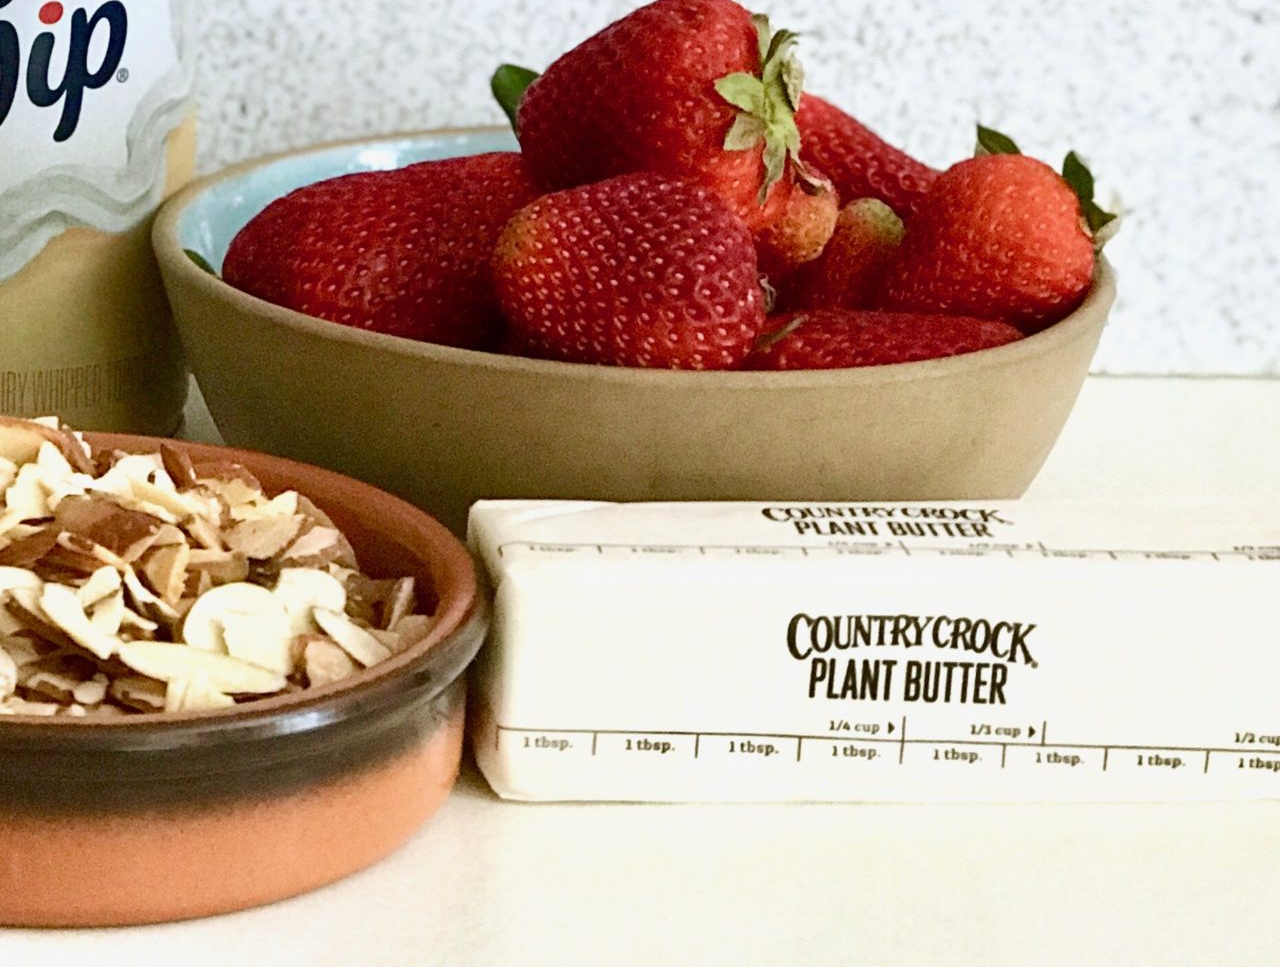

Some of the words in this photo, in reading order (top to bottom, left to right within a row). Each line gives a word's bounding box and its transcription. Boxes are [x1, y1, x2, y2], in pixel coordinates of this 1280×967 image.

[762, 507, 896, 522] COUNTRY
[900, 507, 1014, 525] CROCK
[793, 521, 879, 536] PLANT
[886, 522, 994, 538] BUTTER
[786, 613, 934, 660] COUNTRY
[932, 615, 1037, 665] CROCK
[808, 657, 898, 701] PLANT
[903, 660, 1008, 705] BUTTER
[829, 720, 851, 732] 1/4
[854, 723, 880, 736] cup
[994, 727, 1022, 739] cup
[523, 736, 531, 748] 1
[533, 735, 574, 752] tbsp.
[625, 738, 633, 751] 1
[635, 737, 676, 755] tbsp.
[1234, 732, 1256, 744] 1/2
[728, 740, 735, 753] 1
[739, 739, 780, 758] tbsp.
[831, 745, 838, 757] 1
[842, 744, 881, 761] tbsp.
[933, 748, 940, 761] 1
[943, 747, 983, 765] tbsp.
[1035, 751, 1042, 764] 1
[1045, 751, 1085, 768] tbsp.
[1137, 754, 1144, 766] 1
[1147, 753, 1187, 770] tbsp.
[1238, 757, 1245, 769] 1
